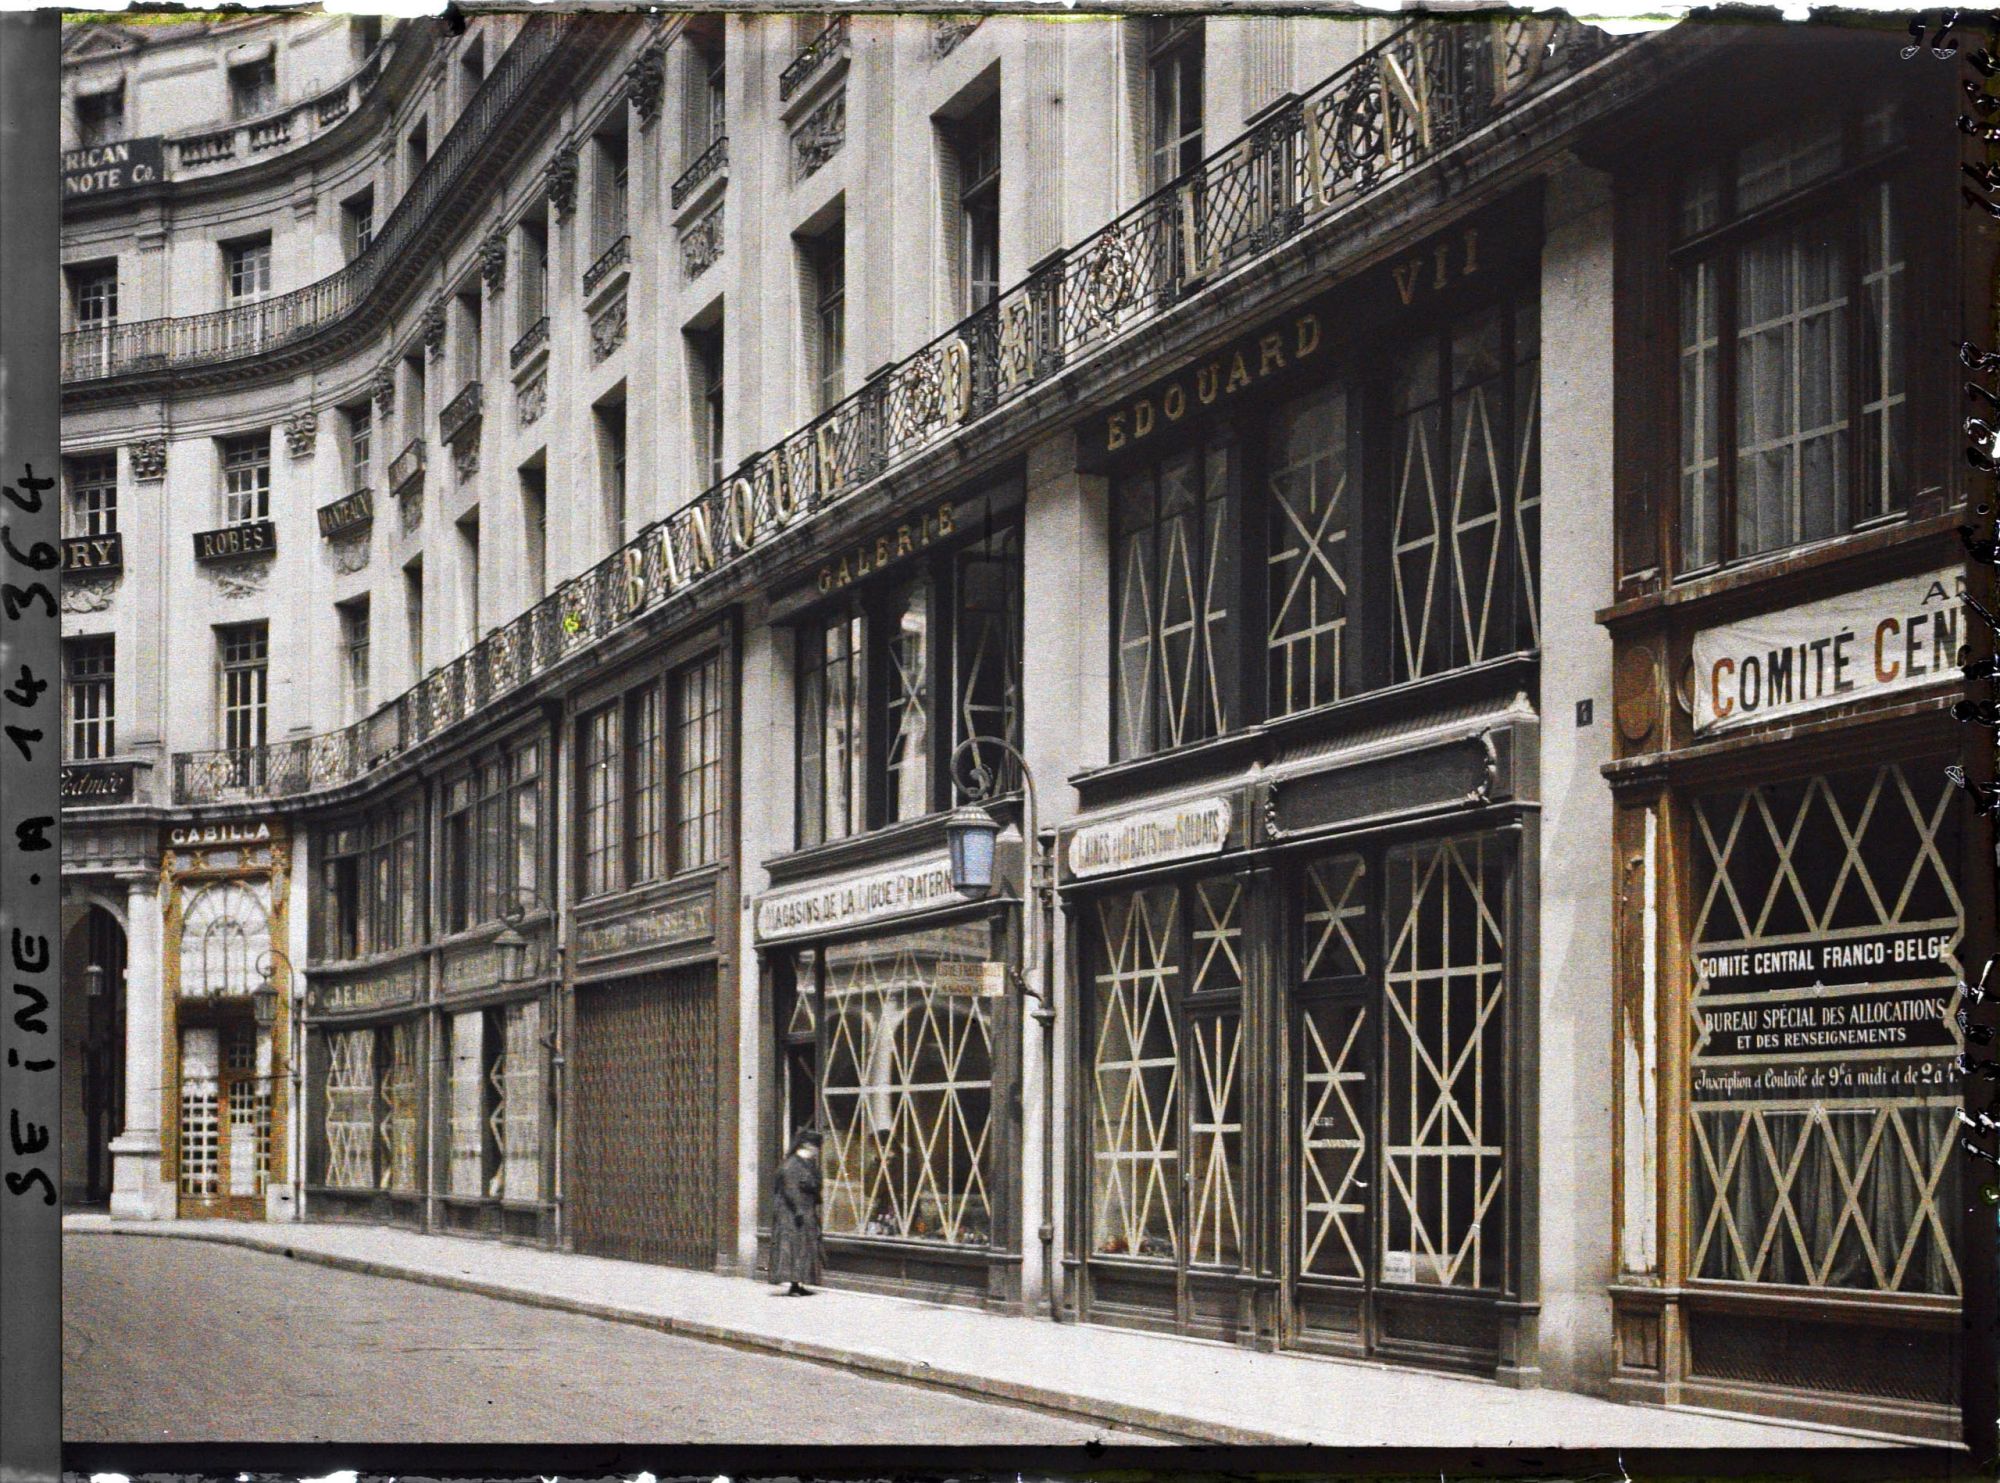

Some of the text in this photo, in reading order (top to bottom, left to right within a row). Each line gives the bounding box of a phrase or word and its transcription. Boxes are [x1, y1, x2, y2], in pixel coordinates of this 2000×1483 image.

[63, 144, 129, 170] RICAN
[66, 169, 121, 193] NOTE
[1107, 227, 1479, 451] EDOUARD VII
[626, 415, 845, 612] BANQUE
[61, 539, 115, 569] RY
[204, 527, 264, 556] ROBES
[818, 502, 956, 595] GALERIE
[1711, 605, 1966, 718] COMITÉ CEN
[765, 898, 820, 930] MAGASINS
[823, 893, 837, 919] DE
[841, 889, 854, 915] LA
[896, 868, 955, 902] FRATERN
[1754, 949, 1815, 975] CENTRAL
[1823, 935, 1950, 968] FRANCO-BELGE
[1705, 998, 1946, 1033] BUREAU SPÉCIAL DES ALLOCATIONS
[1737, 1027, 1906, 1050] ET DES RENSEIGNEMENTS
[1694, 1068, 1751, 1096] Inscription
[1811, 1068, 1825, 1087] de
[1857, 1066, 1887, 1085] midi
[1904, 1065, 1919, 1084] de
